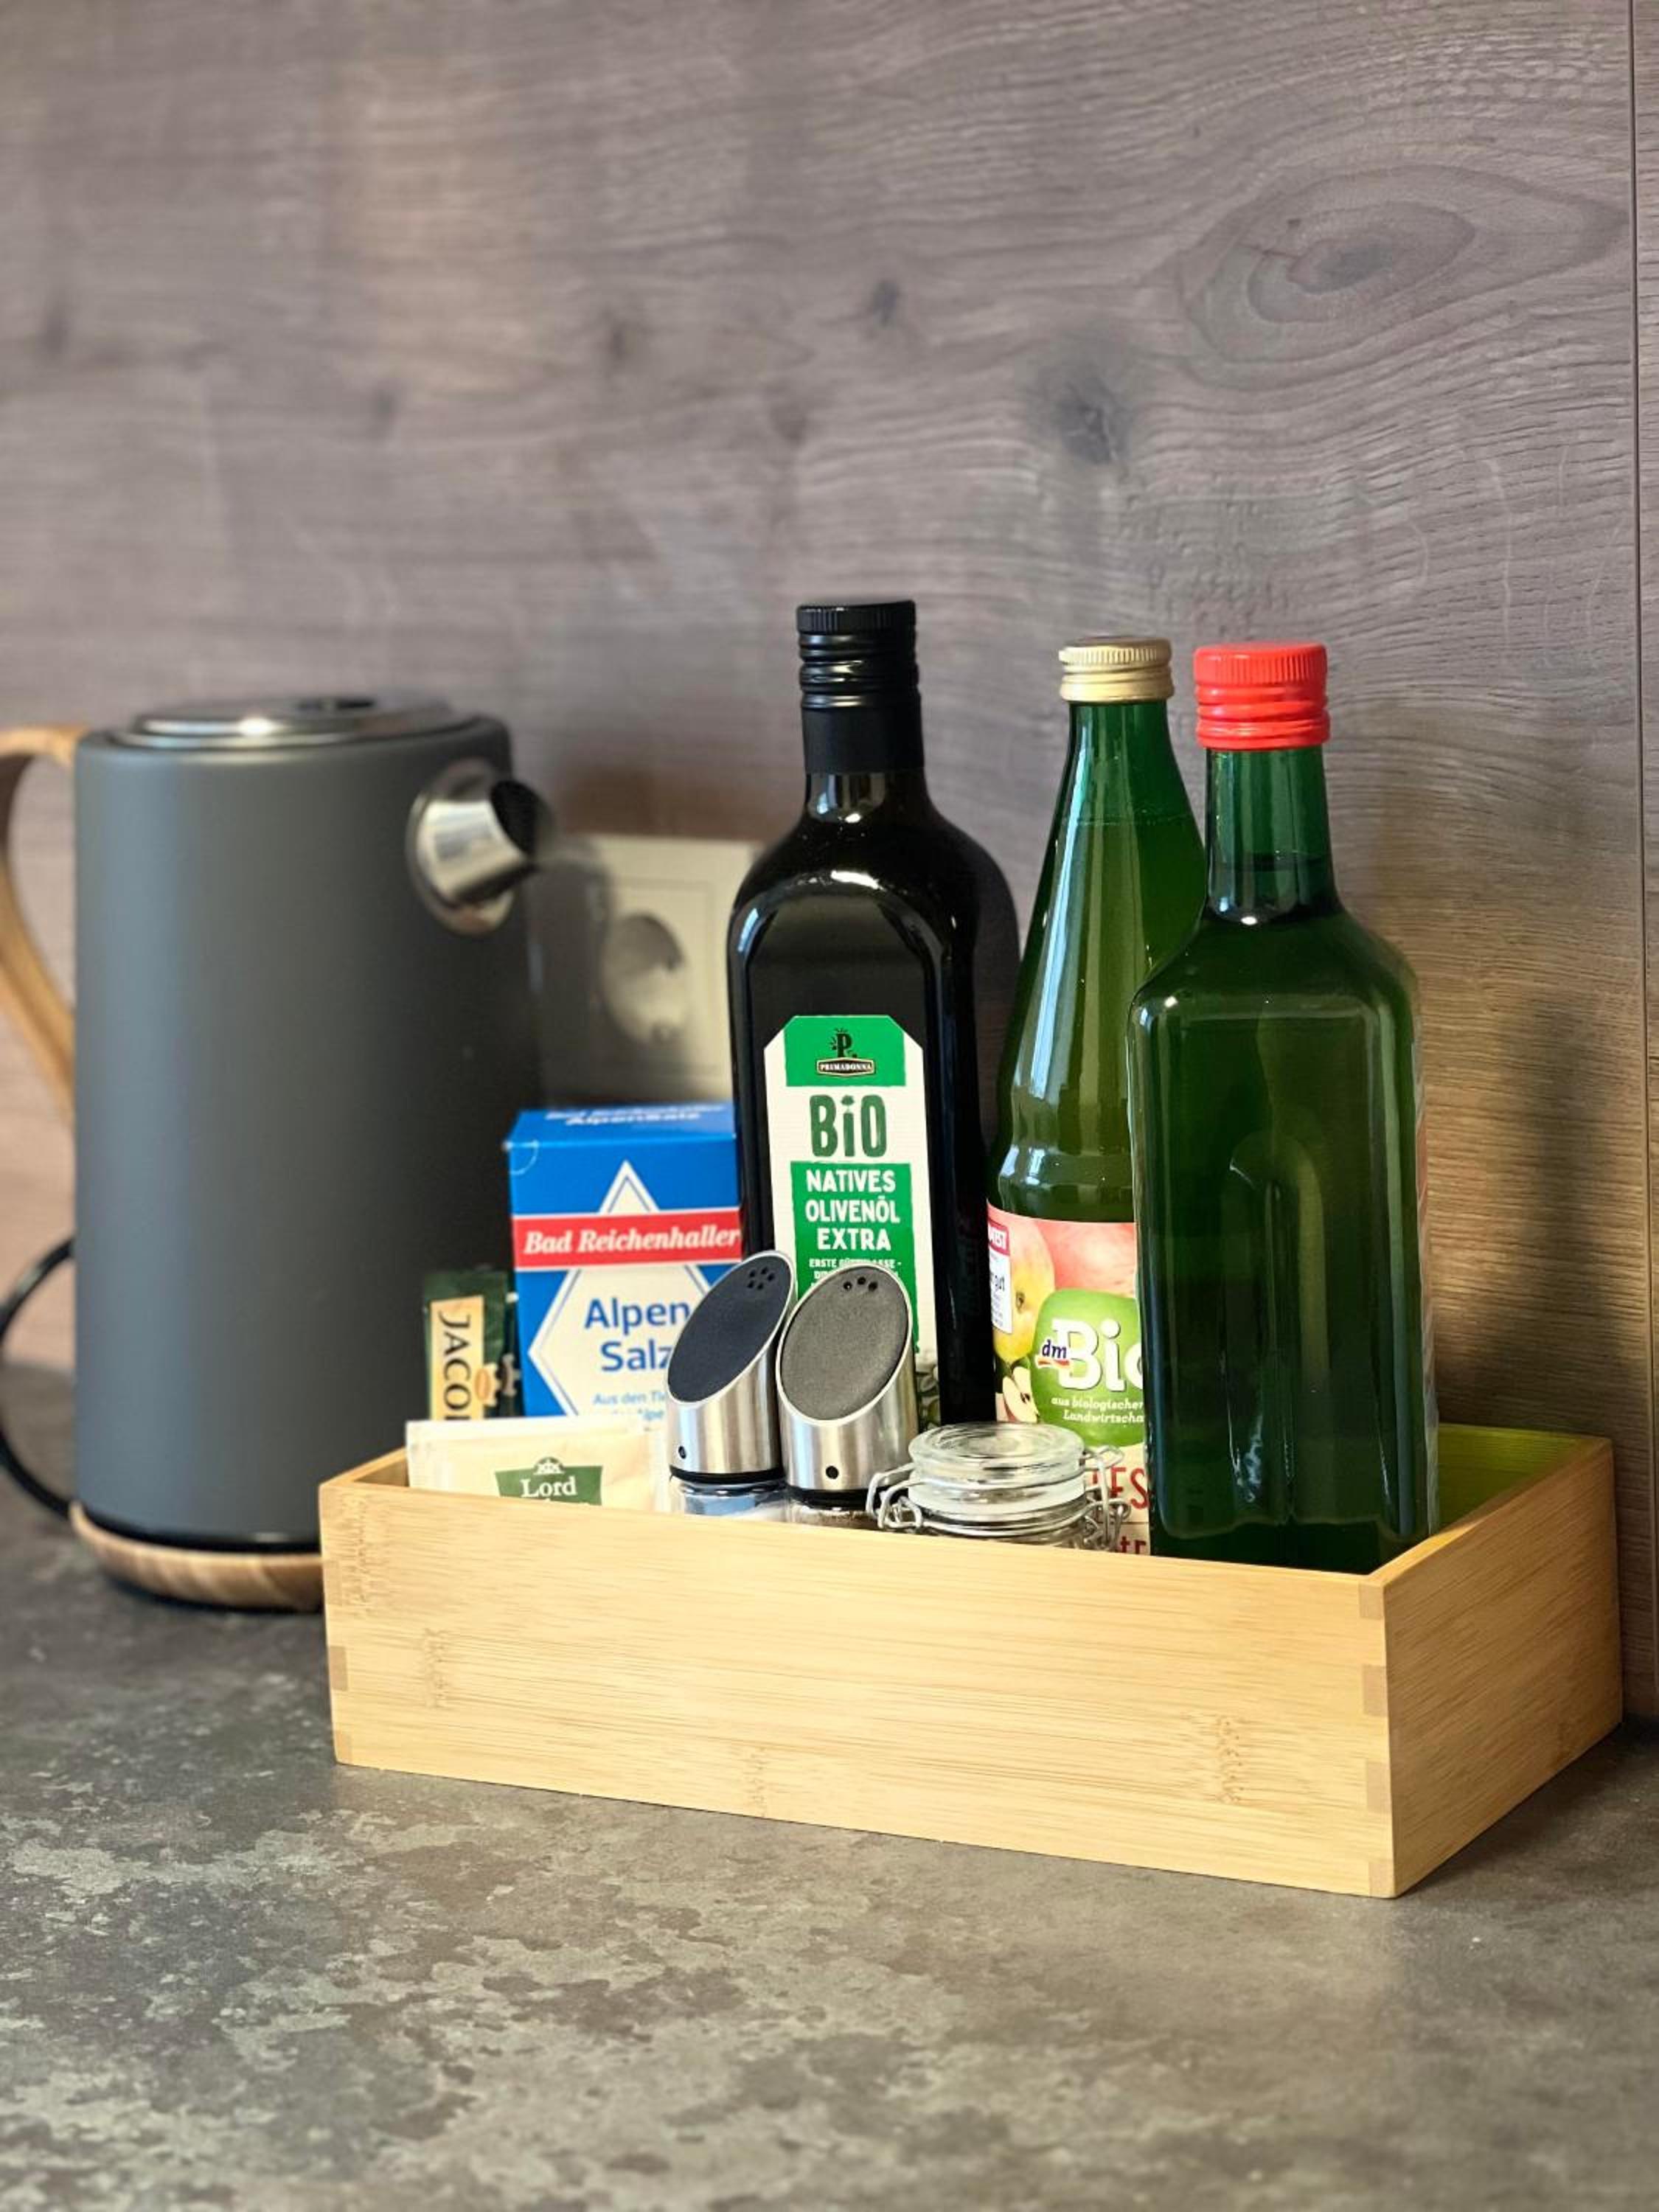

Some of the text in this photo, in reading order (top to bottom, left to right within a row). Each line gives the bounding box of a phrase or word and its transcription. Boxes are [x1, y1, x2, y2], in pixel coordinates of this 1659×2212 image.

[806, 1169, 896, 1192] NATIVES
[805, 1195, 900, 1223] OLIVENÖL
[524, 1224, 741, 1254] Bad Reichenhaller
[817, 1227, 891, 1251] EXTRA
[809, 1258, 837, 1267] ERSTE
[584, 1297, 690, 1336] Alpen
[601, 1338, 672, 1371] Salz
[1042, 1338, 1067, 1358] dm
[1051, 1396, 1069, 1406] aus
[520, 1475, 577, 1498] Lord
